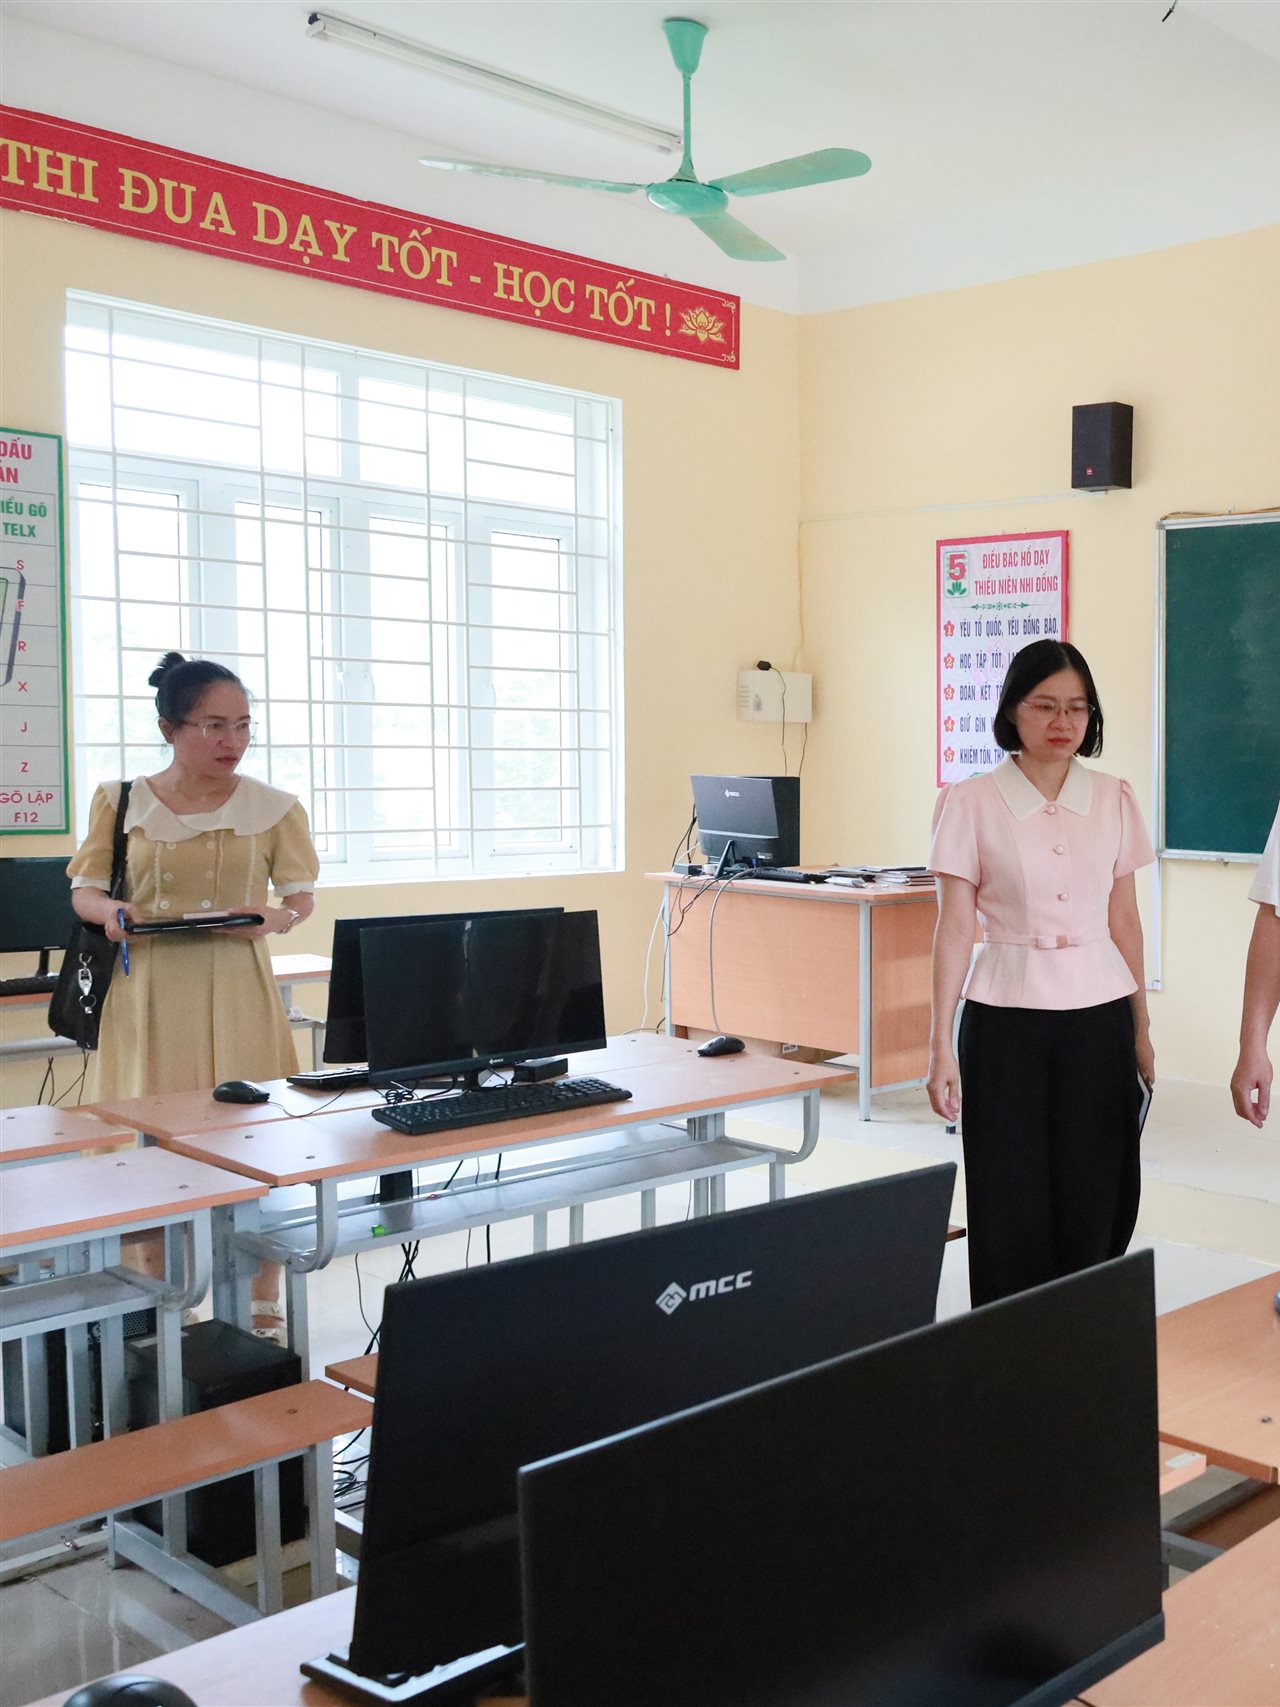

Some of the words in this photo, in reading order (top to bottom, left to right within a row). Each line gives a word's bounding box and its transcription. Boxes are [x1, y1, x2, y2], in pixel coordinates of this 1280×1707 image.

[0, 137, 99, 203] THI
[118, 167, 237, 236] ĐUA
[252, 201, 357, 265] DẠY
[371, 226, 458, 287] TỐT
[493, 262, 575, 317] HỌC
[585, 278, 656, 332] TỐT
[2, 522, 36, 538] TELX
[16, 559, 25, 570] S
[1003, 548, 1019, 568] BÁC
[1034, 549, 1050, 569] DẠY
[948, 553, 967, 581] 5
[999, 575, 1018, 595] NIÊN
[1020, 577, 1034, 594] NHI
[17, 600, 25, 611] F
[18, 640, 27, 652] R
[18, 681, 28, 692] X
[20, 722, 28, 733] J
[20, 762, 29, 773] Z
[0, 790, 23, 803] GÕ
[14, 811, 39, 823] F12
